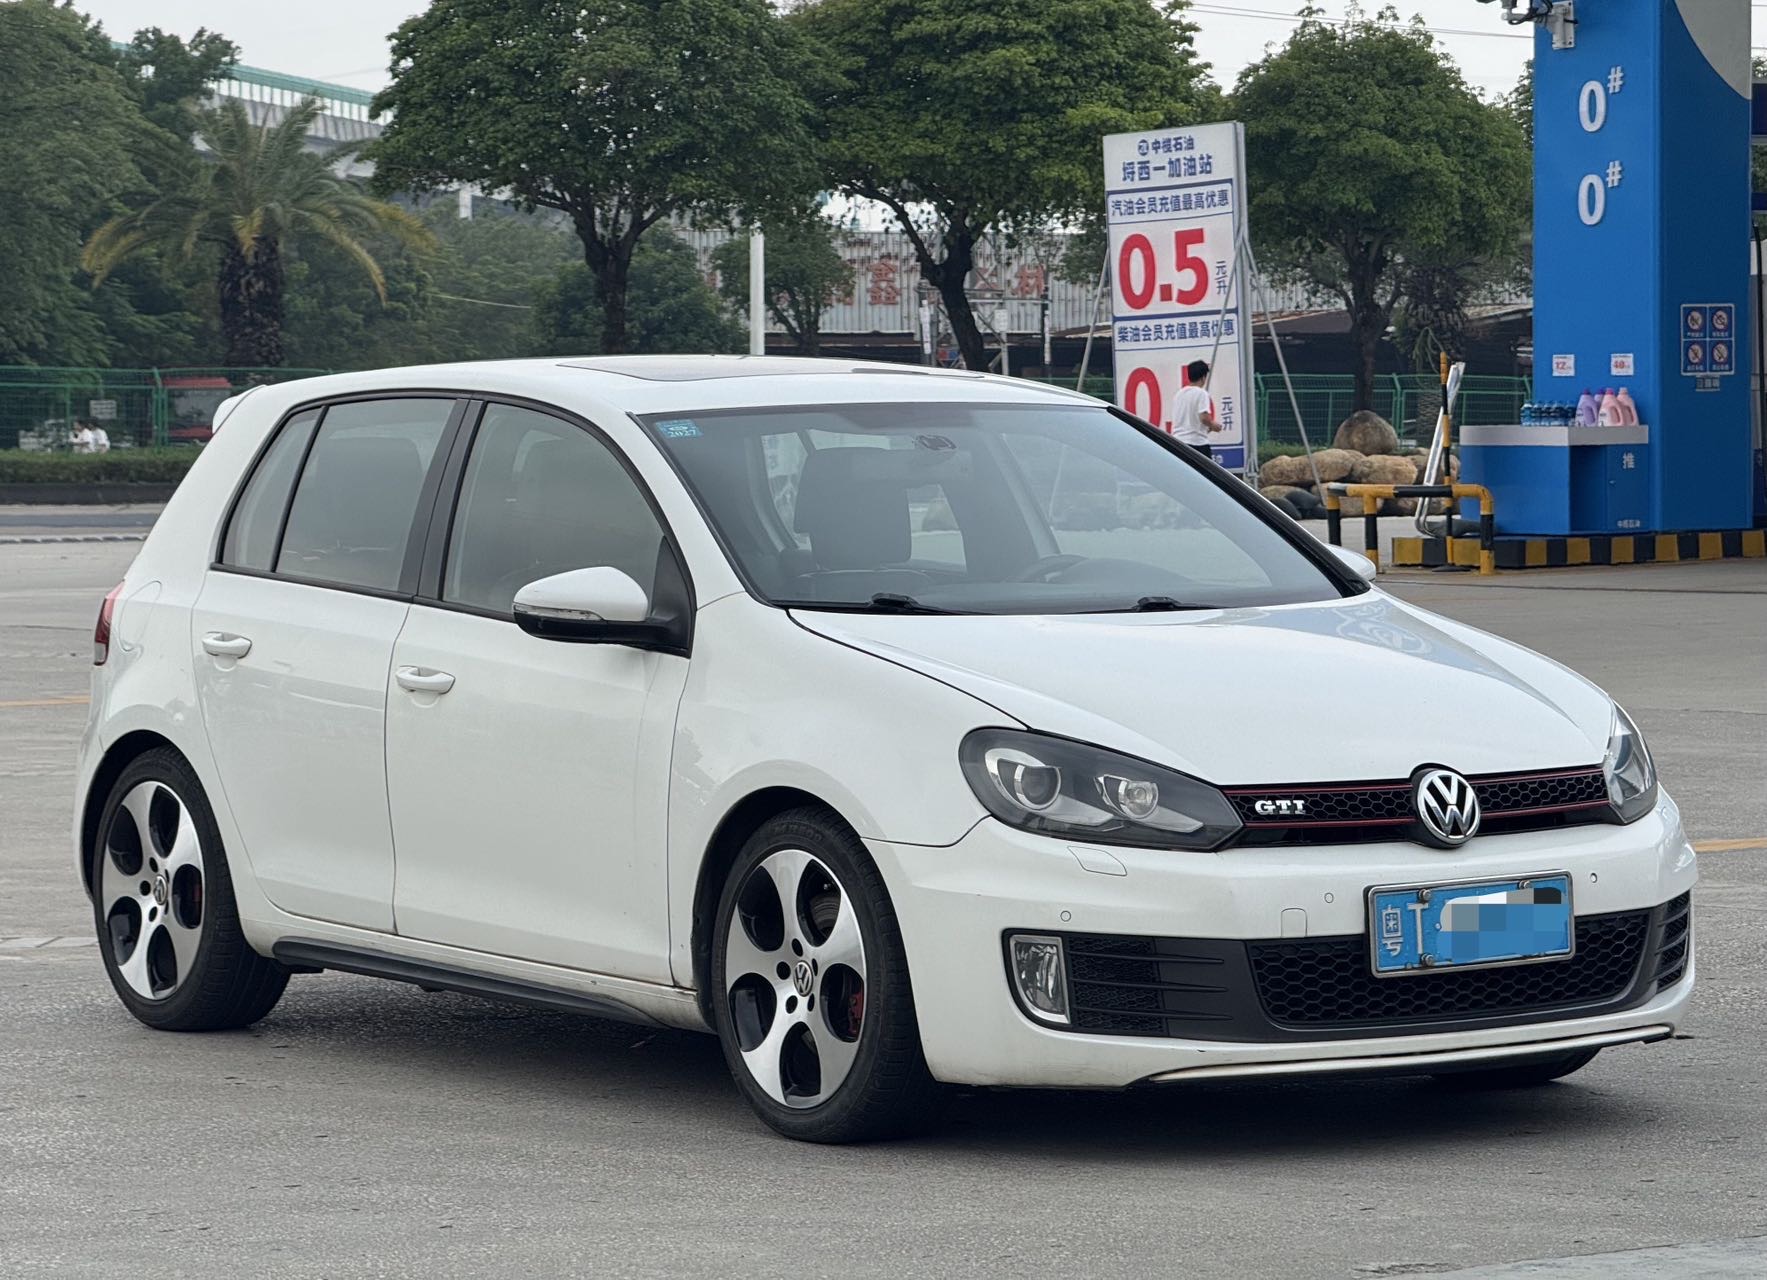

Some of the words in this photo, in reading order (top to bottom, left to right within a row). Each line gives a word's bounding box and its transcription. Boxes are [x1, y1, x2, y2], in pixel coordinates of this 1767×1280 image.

[1579, 66, 1624, 132] 0#
[1111, 189, 1229, 217] 汽油会员充值最高优惠
[1578, 160, 1623, 226] 0#
[1118, 227, 1209, 310] 0.5
[1254, 799, 1305, 815] GTI
